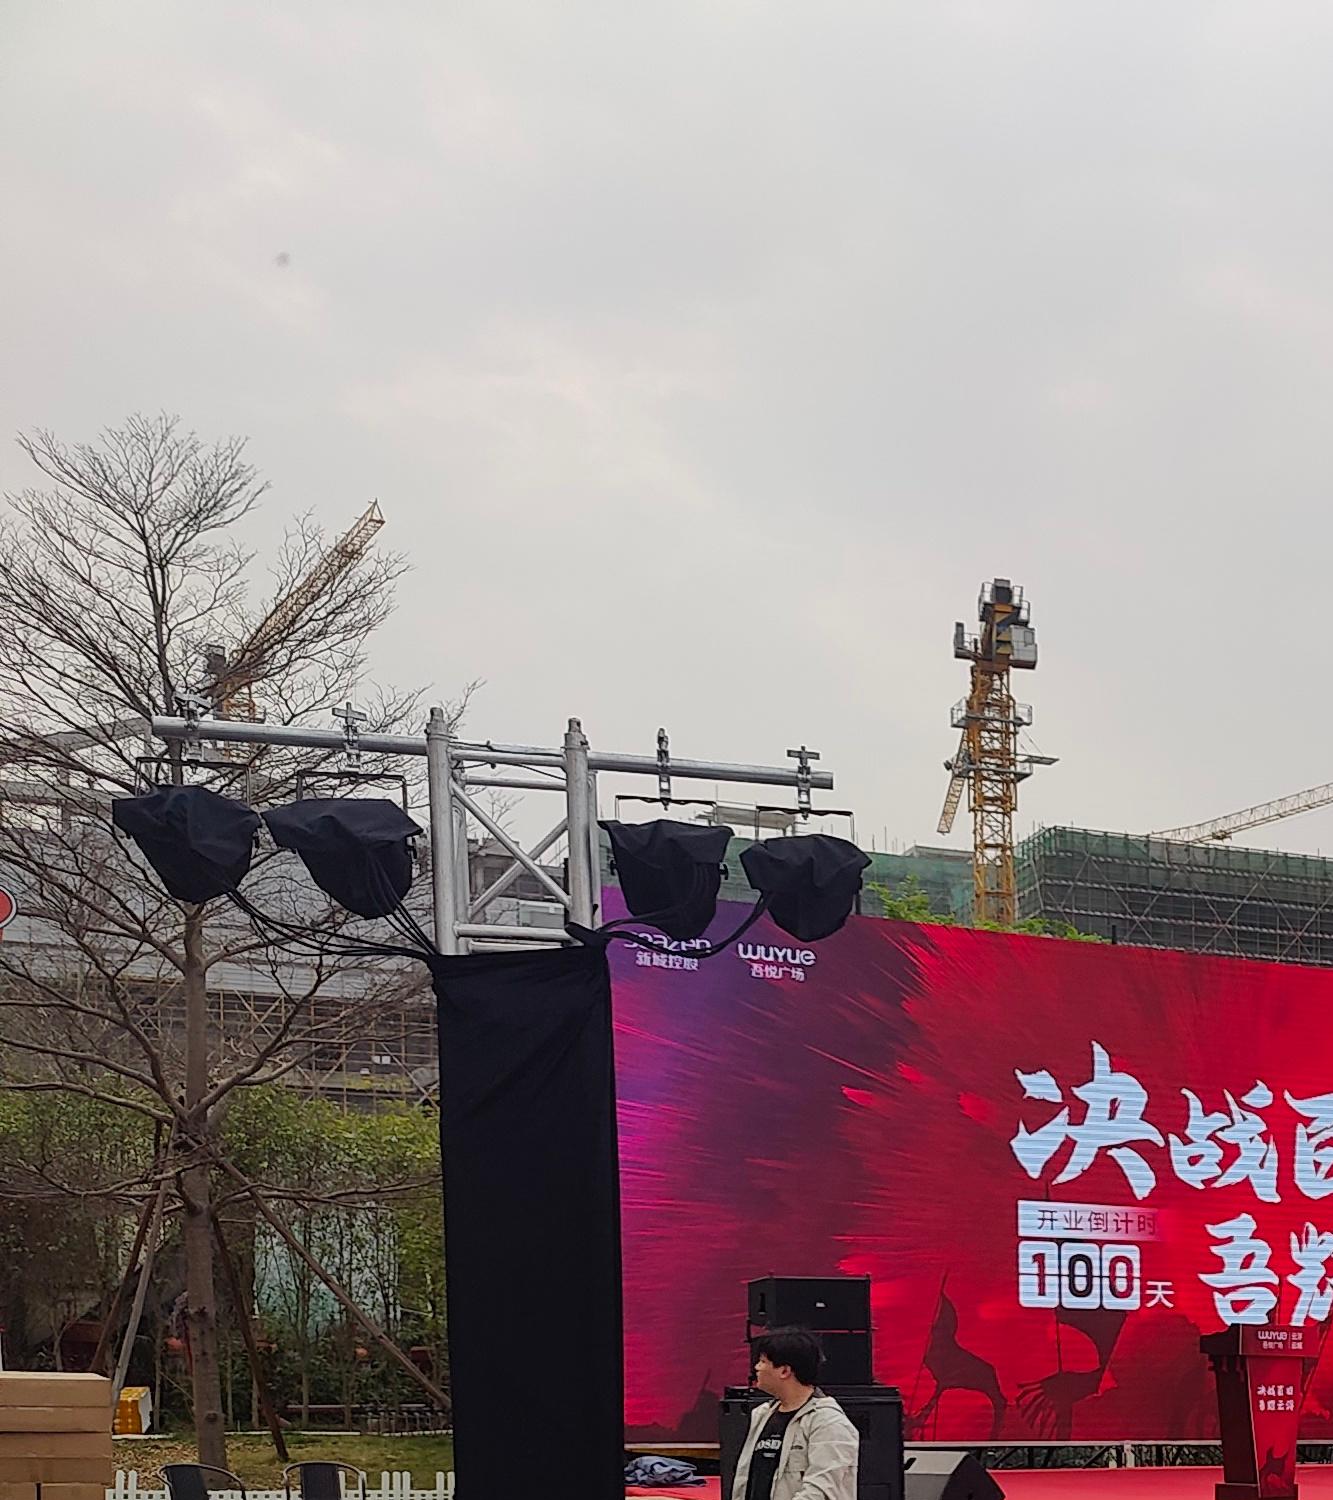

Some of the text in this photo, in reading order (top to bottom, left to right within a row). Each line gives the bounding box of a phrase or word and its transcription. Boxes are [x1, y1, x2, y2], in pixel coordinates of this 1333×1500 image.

[751, 963, 805, 981] 吾悦广场
[1037, 1208, 1157, 1236] 开业倒计时
